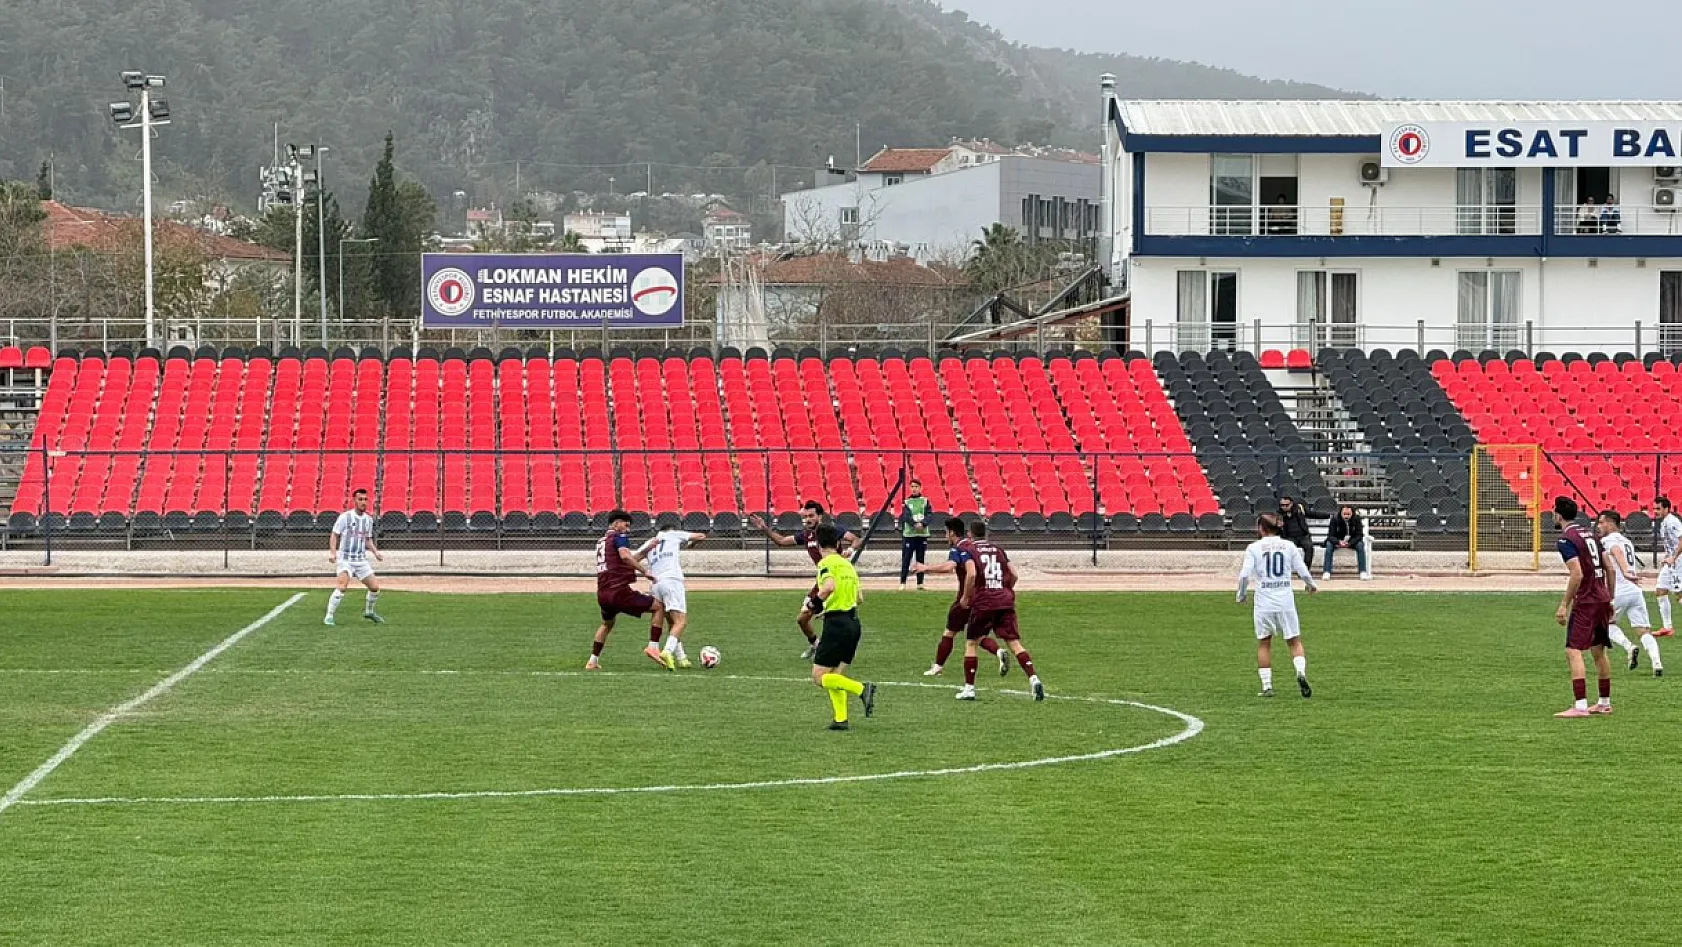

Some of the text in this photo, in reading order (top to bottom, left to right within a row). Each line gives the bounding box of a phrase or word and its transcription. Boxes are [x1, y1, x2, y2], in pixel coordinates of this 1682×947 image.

[1465, 129, 1682, 158] ESAT BA
[483, 268, 562, 284] LOKMAN
[567, 265, 628, 284] HEKİM
[483, 284, 628, 304] ESNAF HASTANESİ
[473, 307, 634, 320] FETHİYESPOR FUTBOL AKADEMİSİ
[1262, 551, 1284, 577] 10
[1586, 538, 1599, 566] 9
[1624, 543, 1634, 566] 8
[981, 554, 1003, 580] 24
